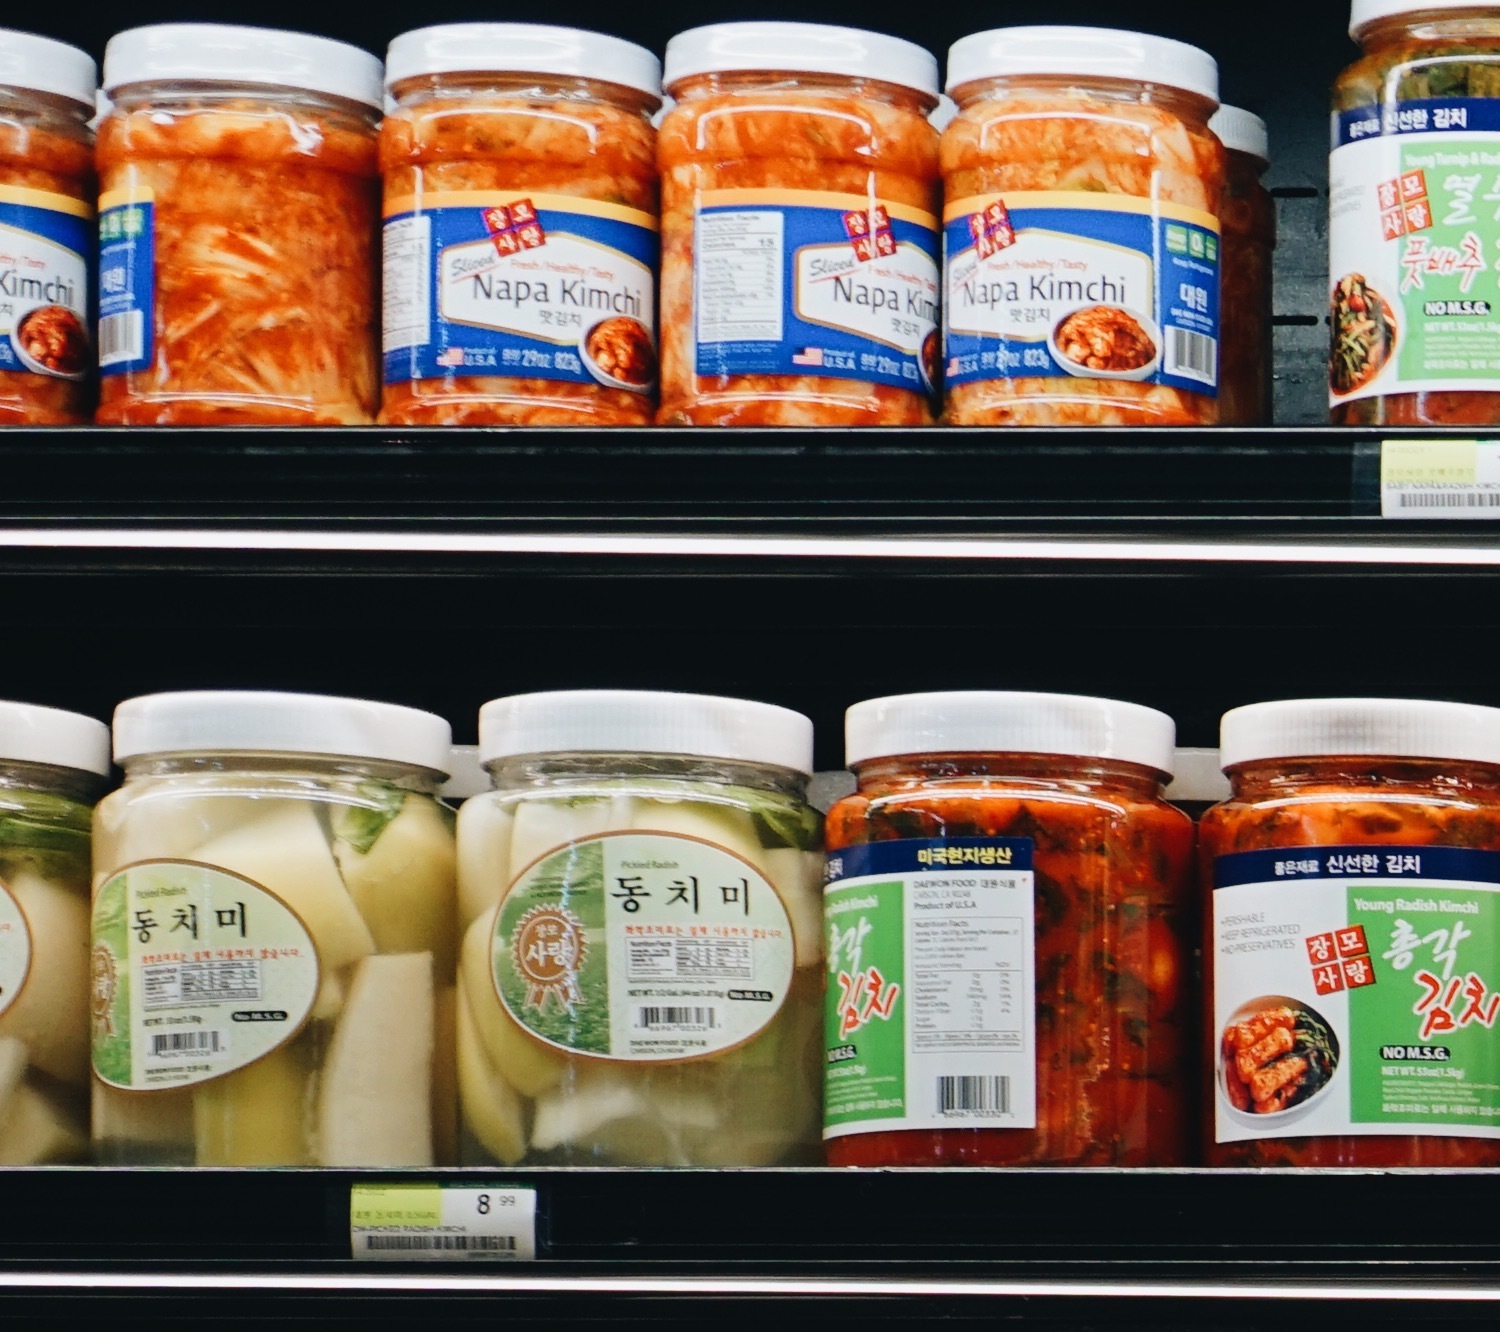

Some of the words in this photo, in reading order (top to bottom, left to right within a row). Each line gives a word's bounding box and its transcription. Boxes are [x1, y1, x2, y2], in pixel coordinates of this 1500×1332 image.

[472, 271, 555, 307] Napa
[560, 278, 643, 317] Kimchi
[962, 276, 1024, 309] Napa
[1030, 274, 1126, 306] Kimchi
[917, 844, 1012, 866] 미국현지생산
[1326, 854, 1380, 874] 신선한
[1384, 853, 1421, 874] 김치
[609, 874, 752, 916] 동치미
[1353, 897, 1393, 914] Young
[1396, 899, 1437, 914] Radish
[1439, 898, 1479, 914] Kimchi
[130, 902, 248, 945] 동치미
[1382, 919, 1472, 975] 총각
[1381, 1046, 1402, 1059] NO
[1404, 1046, 1450, 1060] M.S.G.
[476, 1194, 491, 1216] 8
[499, 1195, 515, 1206] 99
